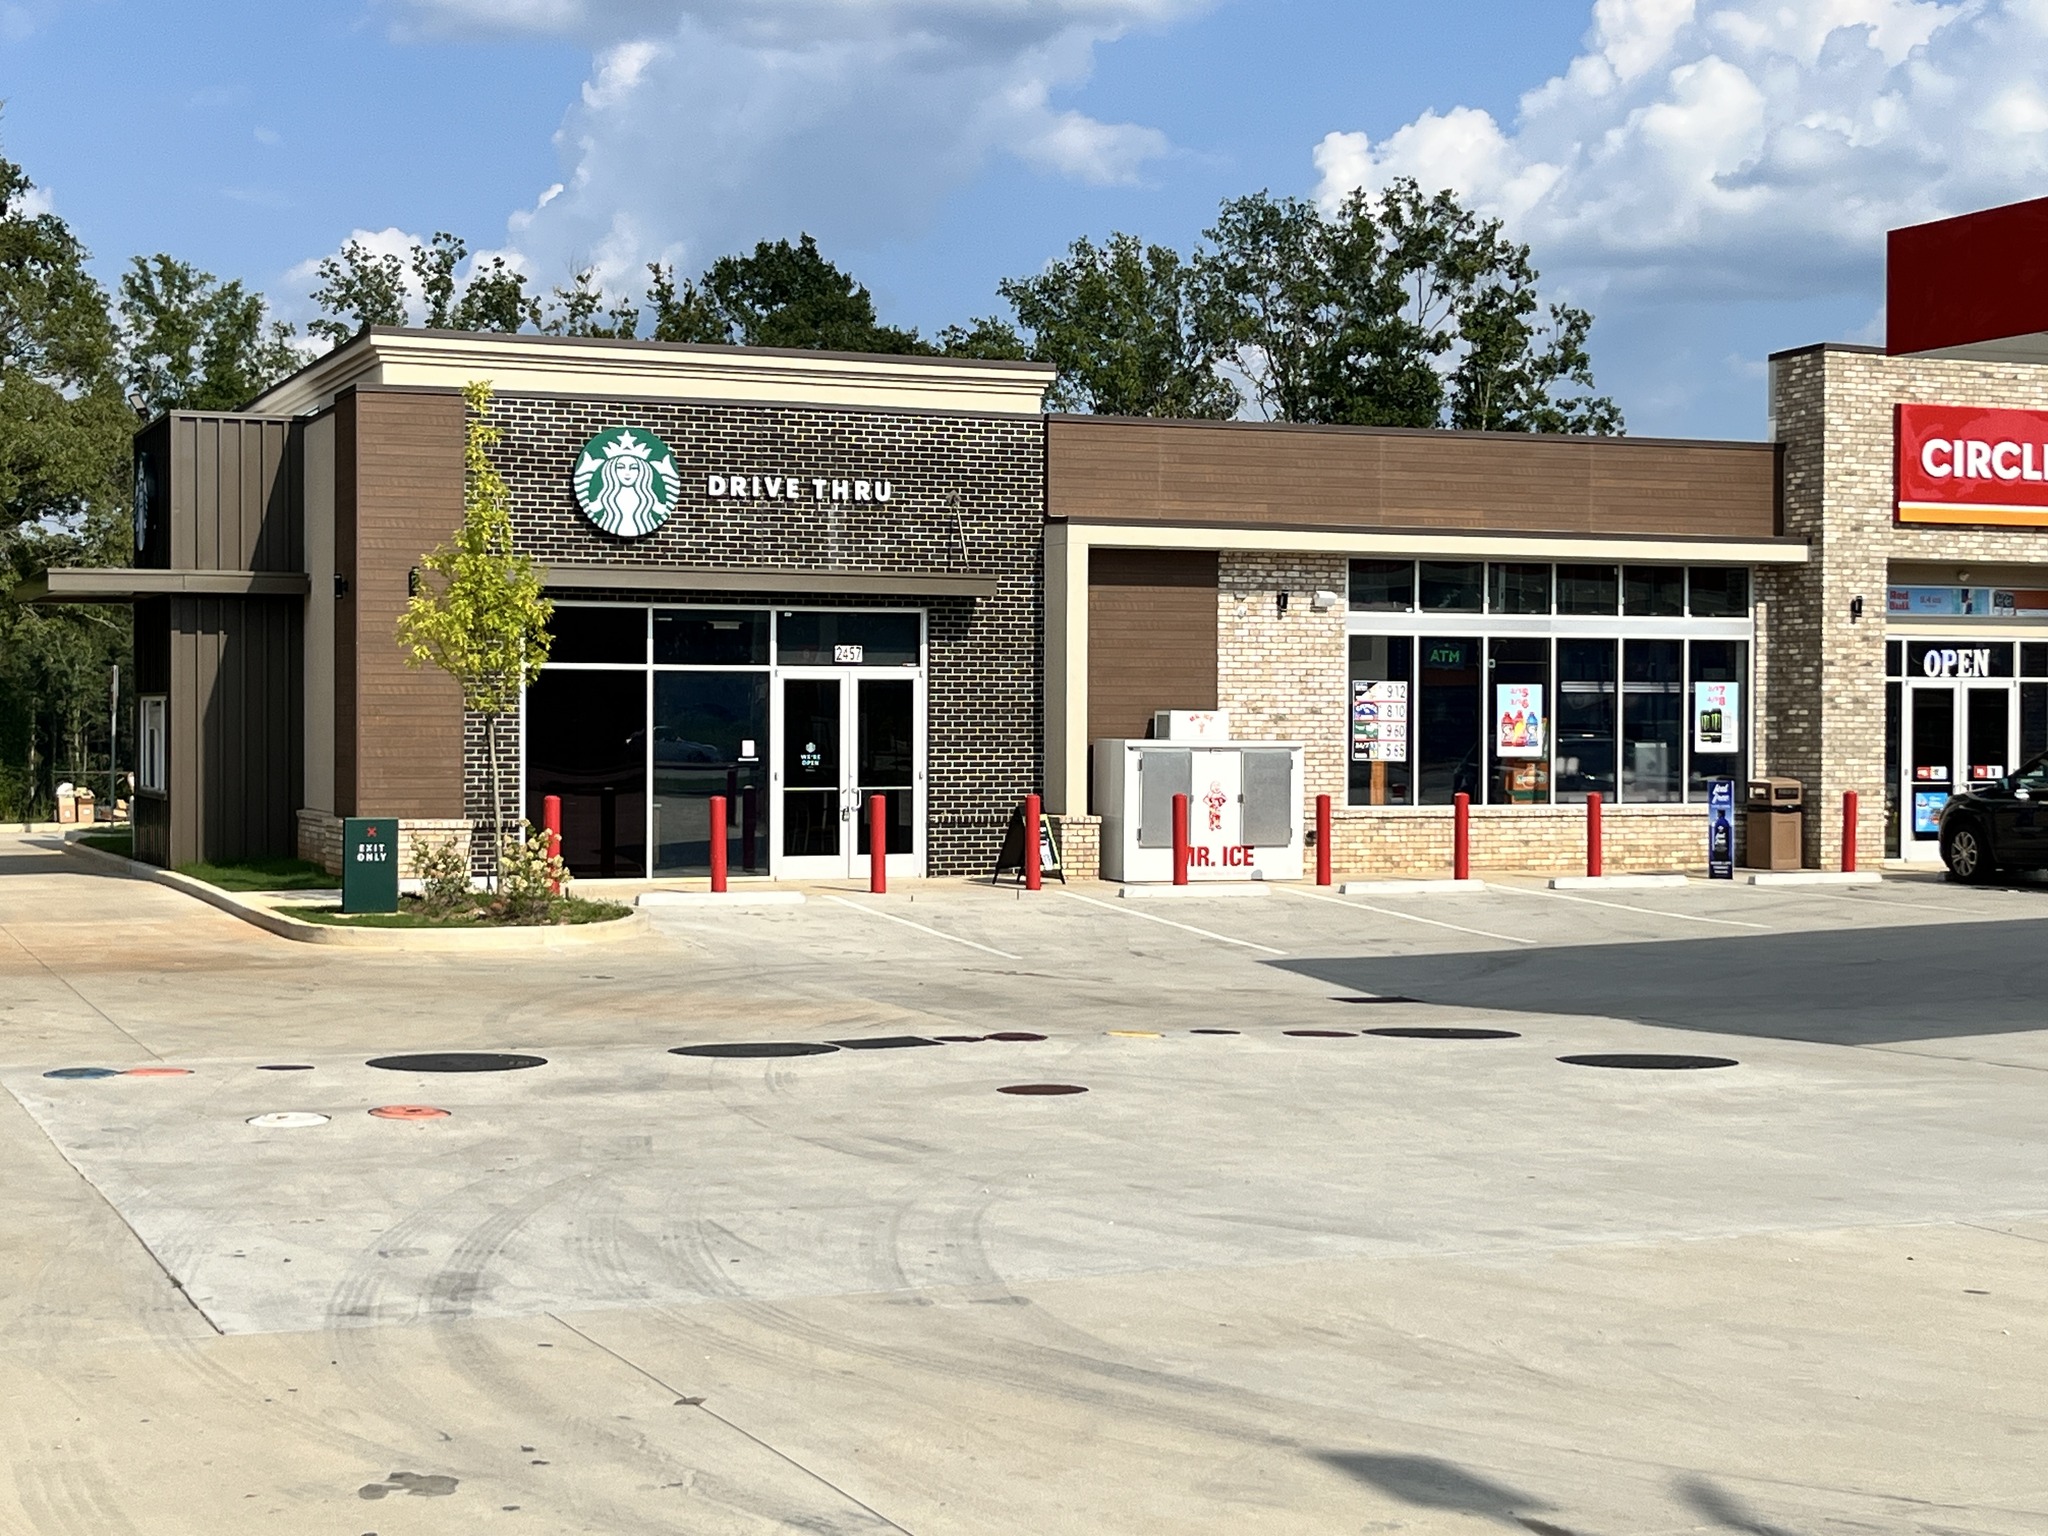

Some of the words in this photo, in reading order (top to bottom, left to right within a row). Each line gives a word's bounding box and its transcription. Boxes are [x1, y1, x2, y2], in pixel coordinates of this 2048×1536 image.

[708, 475, 800, 499] DRIVE
[812, 479, 891, 502] THRU
[836, 646, 862, 661] 2457
[1430, 649, 1460, 663] ATM
[1923, 649, 1990, 677] OPEN
[359, 843, 386, 853] EXIT
[356, 853, 387, 862] ONLY
[1222, 845, 1255, 867] ICE
